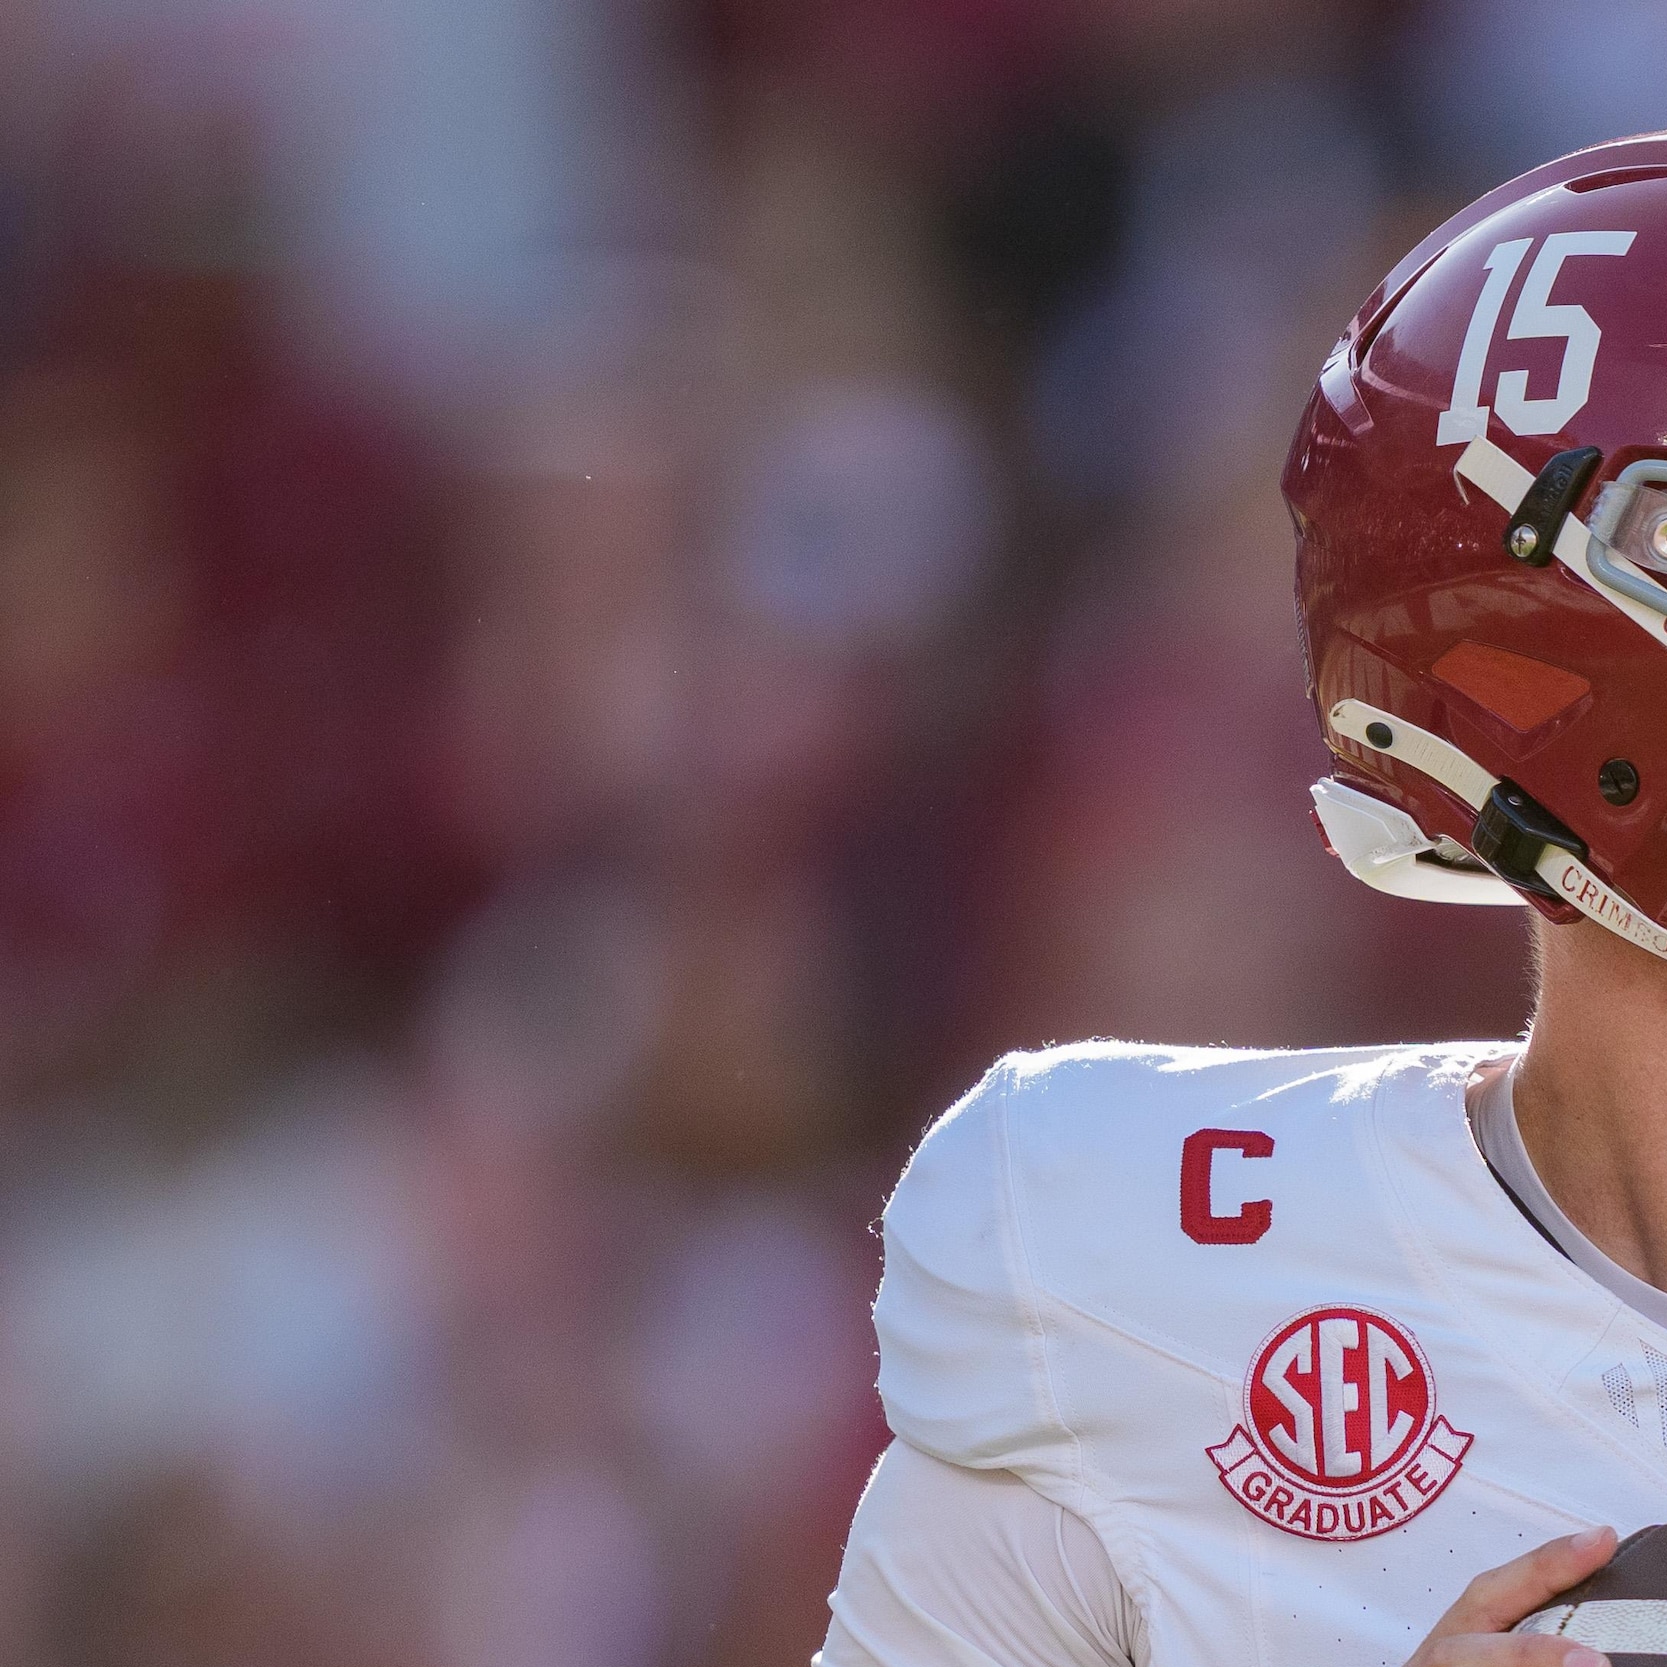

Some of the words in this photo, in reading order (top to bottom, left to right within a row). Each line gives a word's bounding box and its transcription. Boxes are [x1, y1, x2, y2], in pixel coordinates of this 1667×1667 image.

[1436, 231, 1637, 447] 15
[1180, 1128, 1275, 1245] C
[1261, 1317, 1415, 1478] SEC
[1242, 1463, 1438, 1534] GRADUATE
